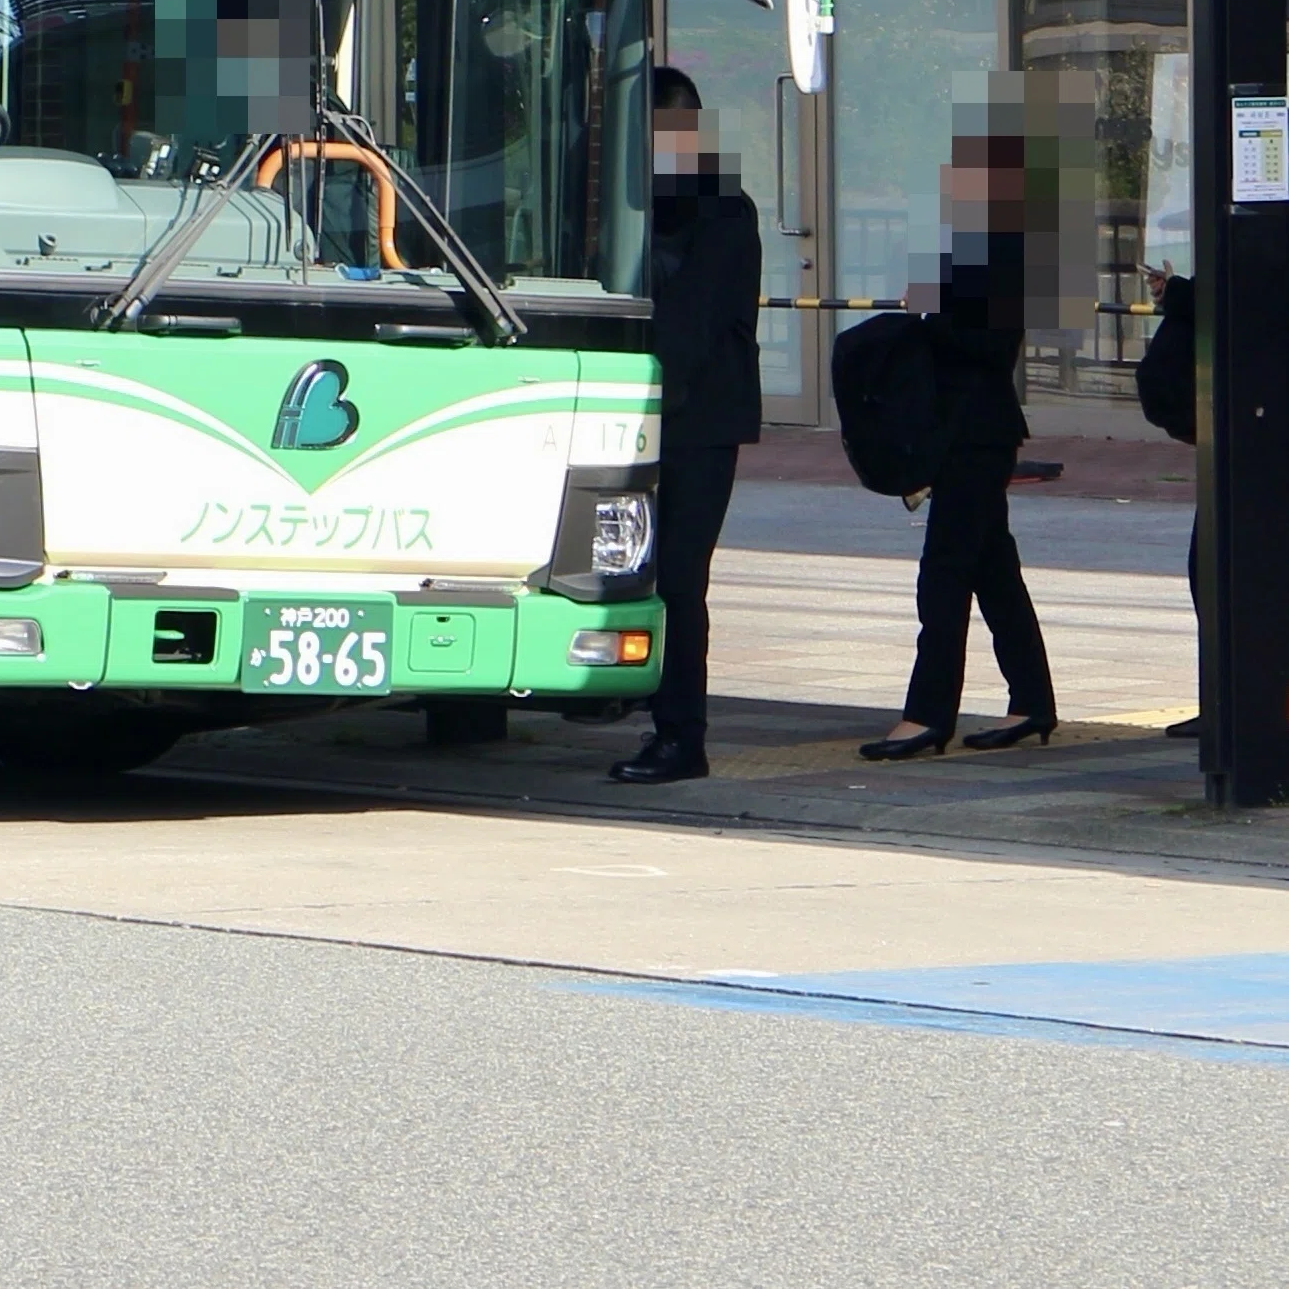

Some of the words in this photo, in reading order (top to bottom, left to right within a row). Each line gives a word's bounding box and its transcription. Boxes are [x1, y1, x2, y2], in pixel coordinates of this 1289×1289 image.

[601, 421, 647, 453] 176
[179, 501, 434, 551] ノンステップバス
[269, 629, 387, 687] 58-65
